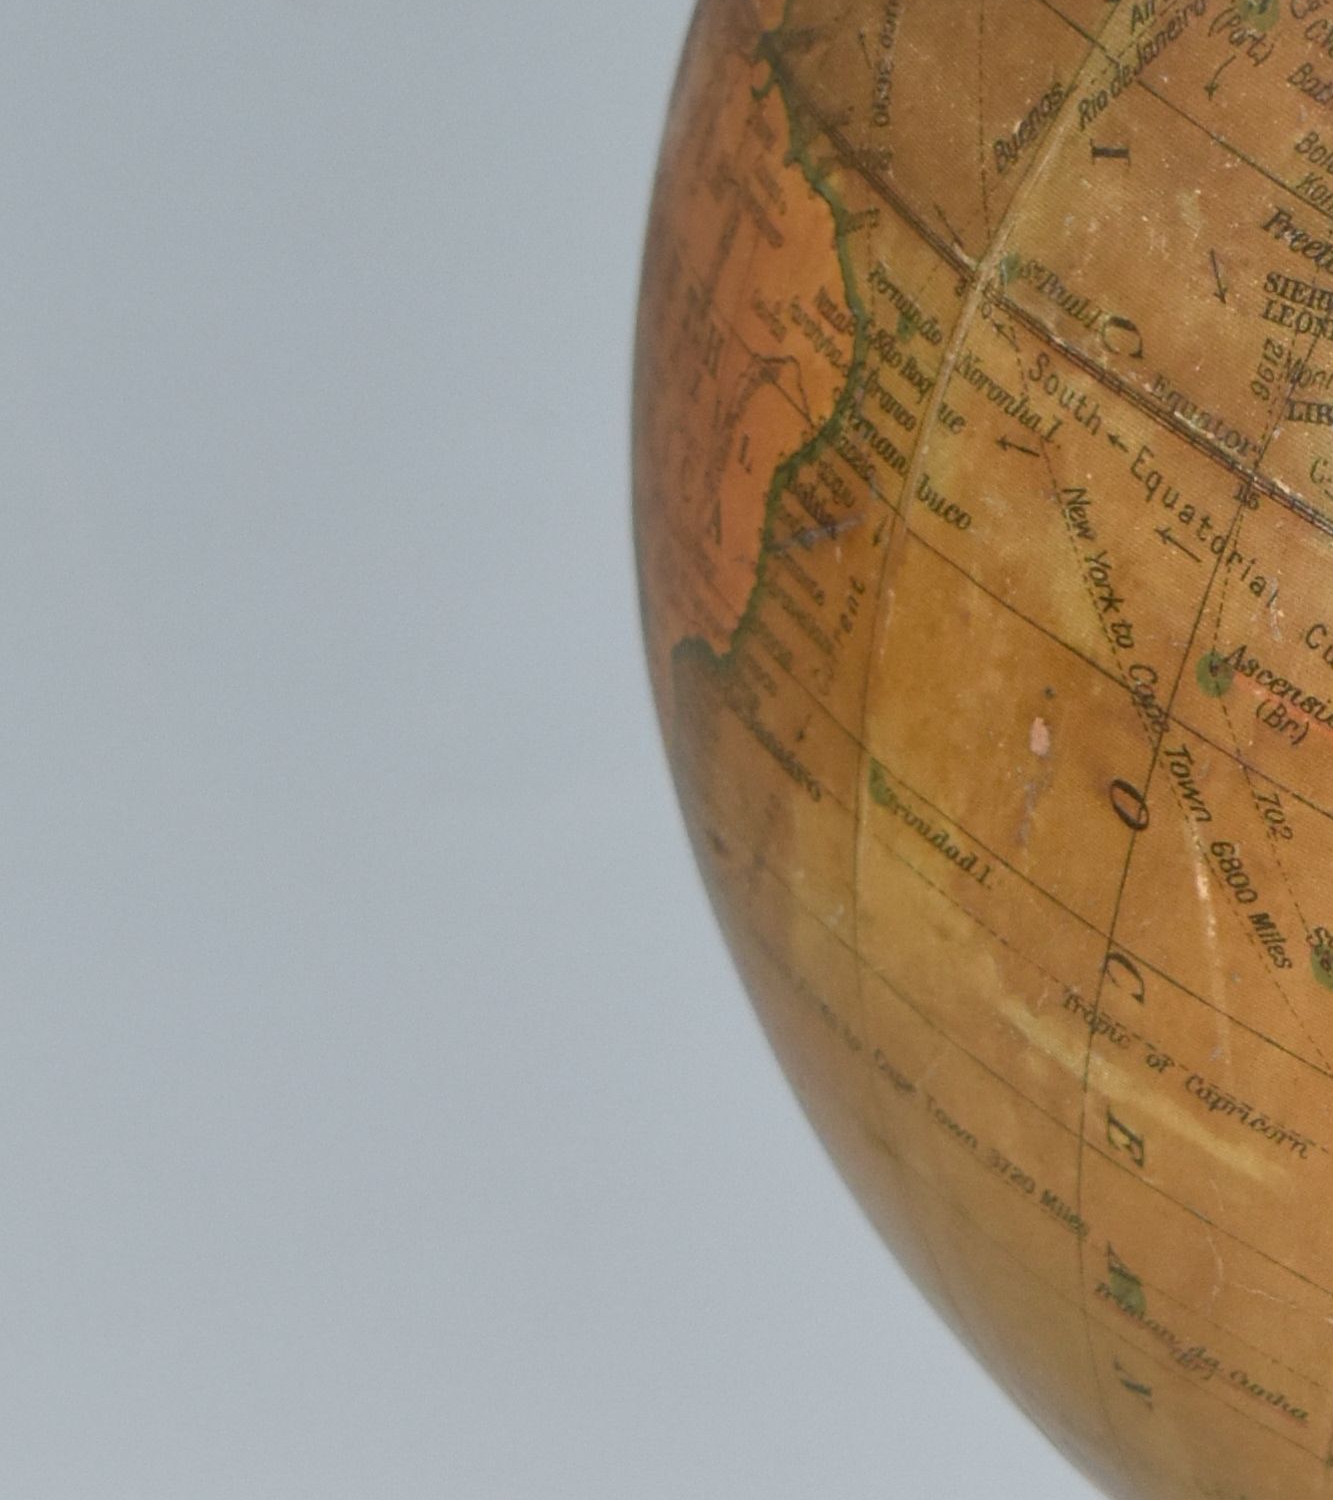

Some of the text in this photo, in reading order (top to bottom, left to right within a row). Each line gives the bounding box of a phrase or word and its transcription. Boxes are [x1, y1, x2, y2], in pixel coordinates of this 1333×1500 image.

[1029, 352, 1103, 435] South
[1130, 444, 1279, 608] Equatorial
[1061, 485, 1098, 541] New
[1085, 548, 1124, 614] York
[1110, 618, 1136, 650] to
[1161, 742, 1213, 823] Town
[1210, 840, 1260, 905] 6800
[1248, 912, 1294, 970] Miles
